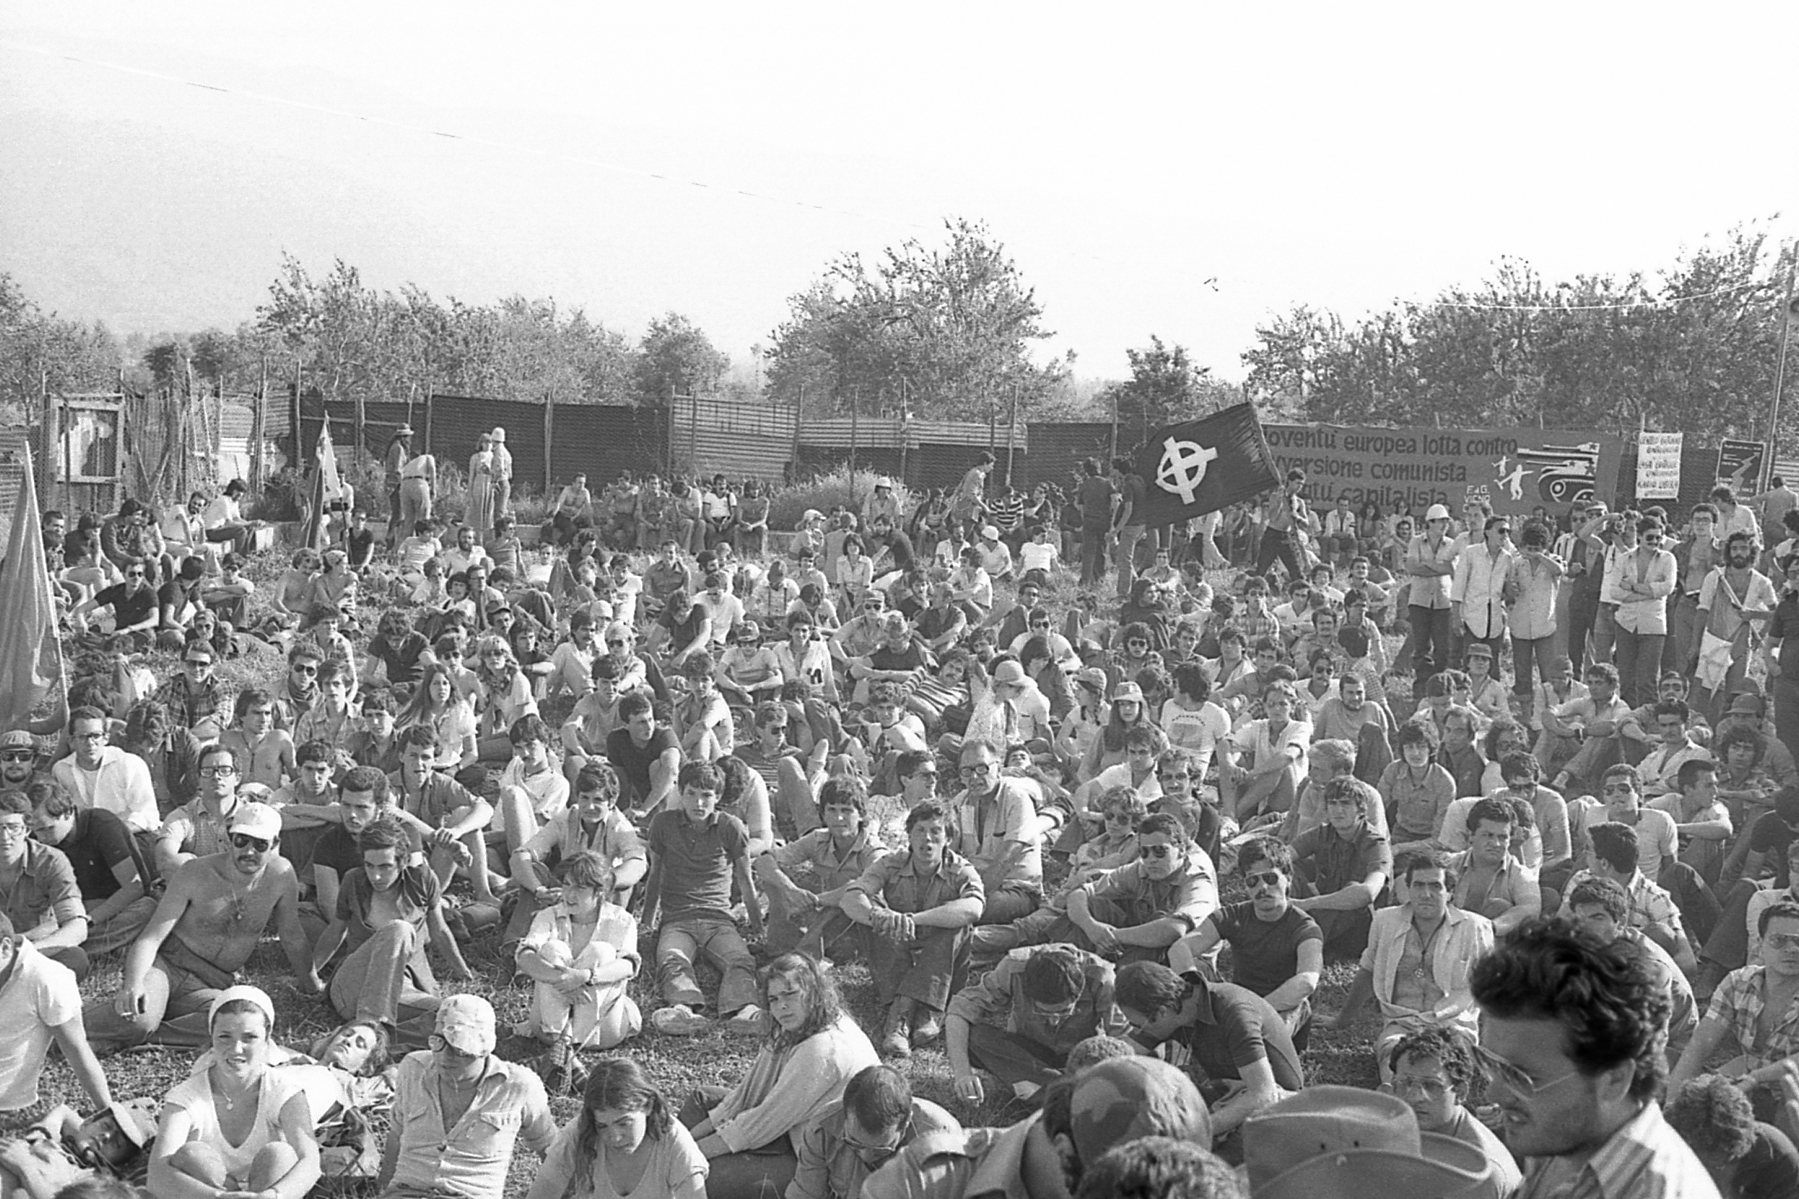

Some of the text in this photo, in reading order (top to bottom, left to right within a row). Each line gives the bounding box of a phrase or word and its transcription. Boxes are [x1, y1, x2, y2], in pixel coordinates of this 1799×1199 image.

[1344, 435, 1416, 457] europea
[1423, 435, 1461, 455] lotta
[1466, 438, 1517, 455] contro
[1371, 462, 1466, 481] comunista
